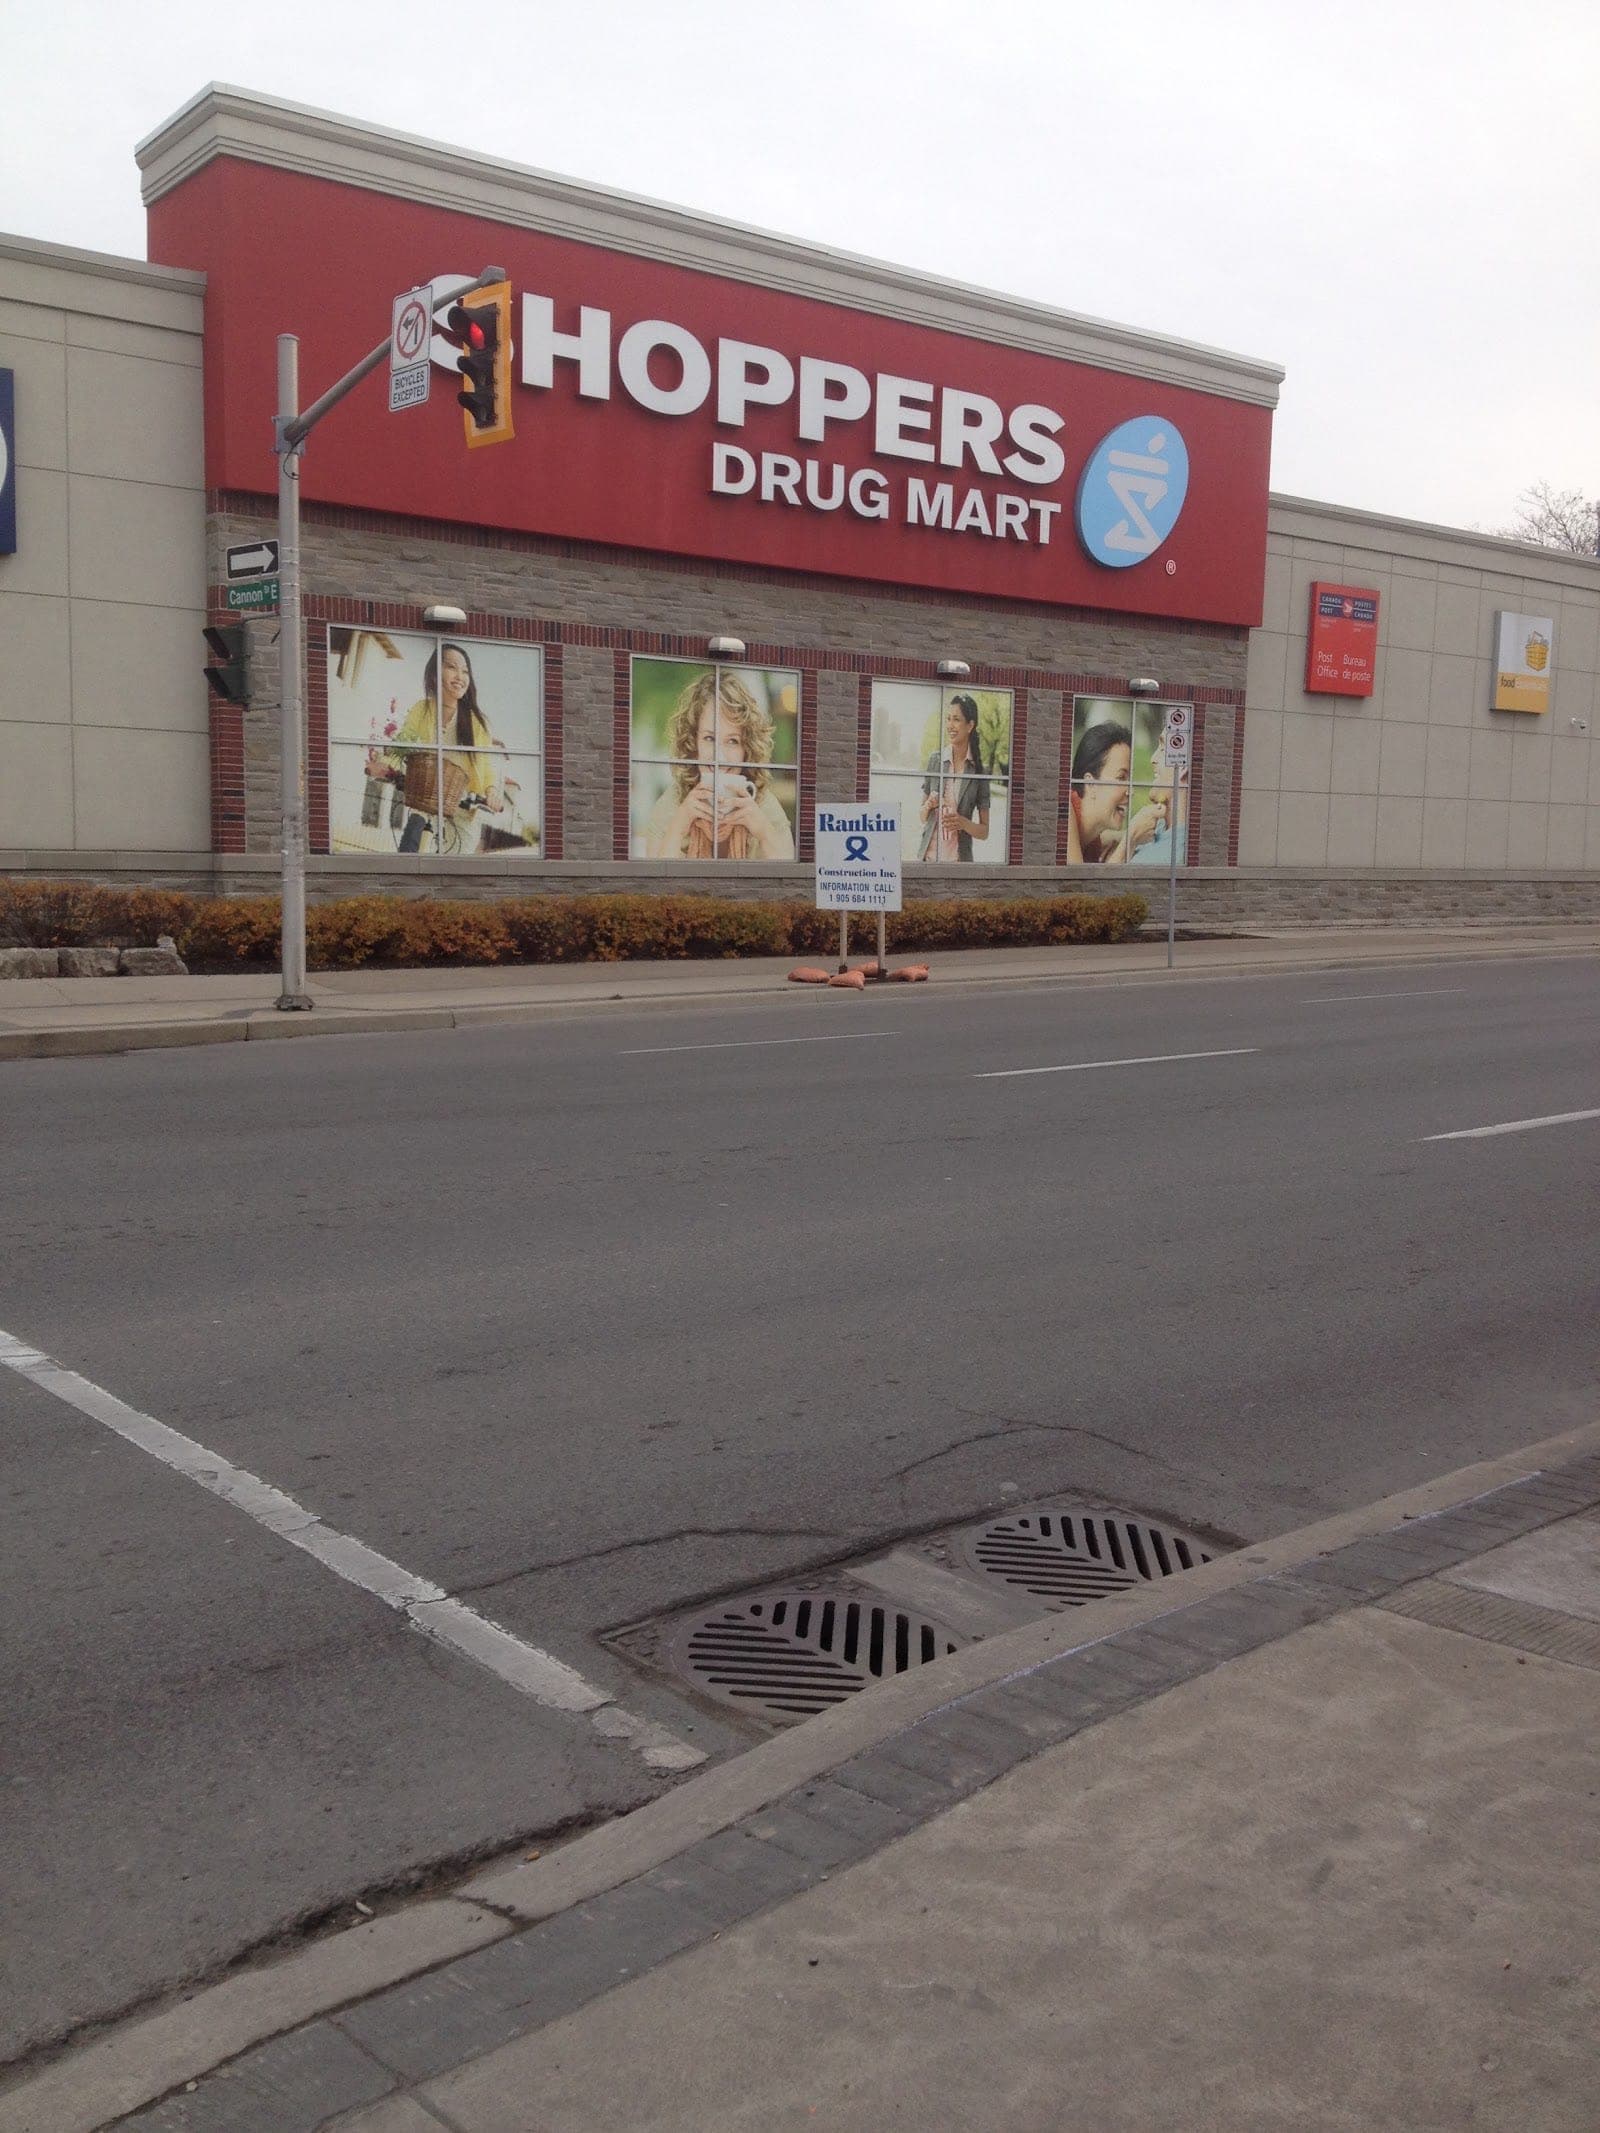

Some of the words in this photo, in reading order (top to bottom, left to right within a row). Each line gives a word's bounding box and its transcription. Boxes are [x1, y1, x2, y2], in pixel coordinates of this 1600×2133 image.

[395, 370, 425, 390] BICYCLES
[393, 386, 425, 404] EXCEPTED
[712, 441, 890, 520] DRUG
[907, 477, 1062, 545] MART
[229, 589, 263, 605] Cannon
[271, 584, 278, 600] E
[1318, 651, 1333, 663] Post
[1343, 655, 1367, 667] Bureau
[1317, 665, 1338, 679] Office
[1343, 669, 1351, 679] de
[1352, 672, 1371, 682] poste
[1501, 676, 1516, 688] food
[818, 813, 896, 832] Rankin
[818, 867, 877, 878] Construction
[880, 869, 897, 878] Inc.
[820, 882, 870, 892] INFORMATION
[829, 894, 833, 902] 1
[836, 894, 850, 903] 905
